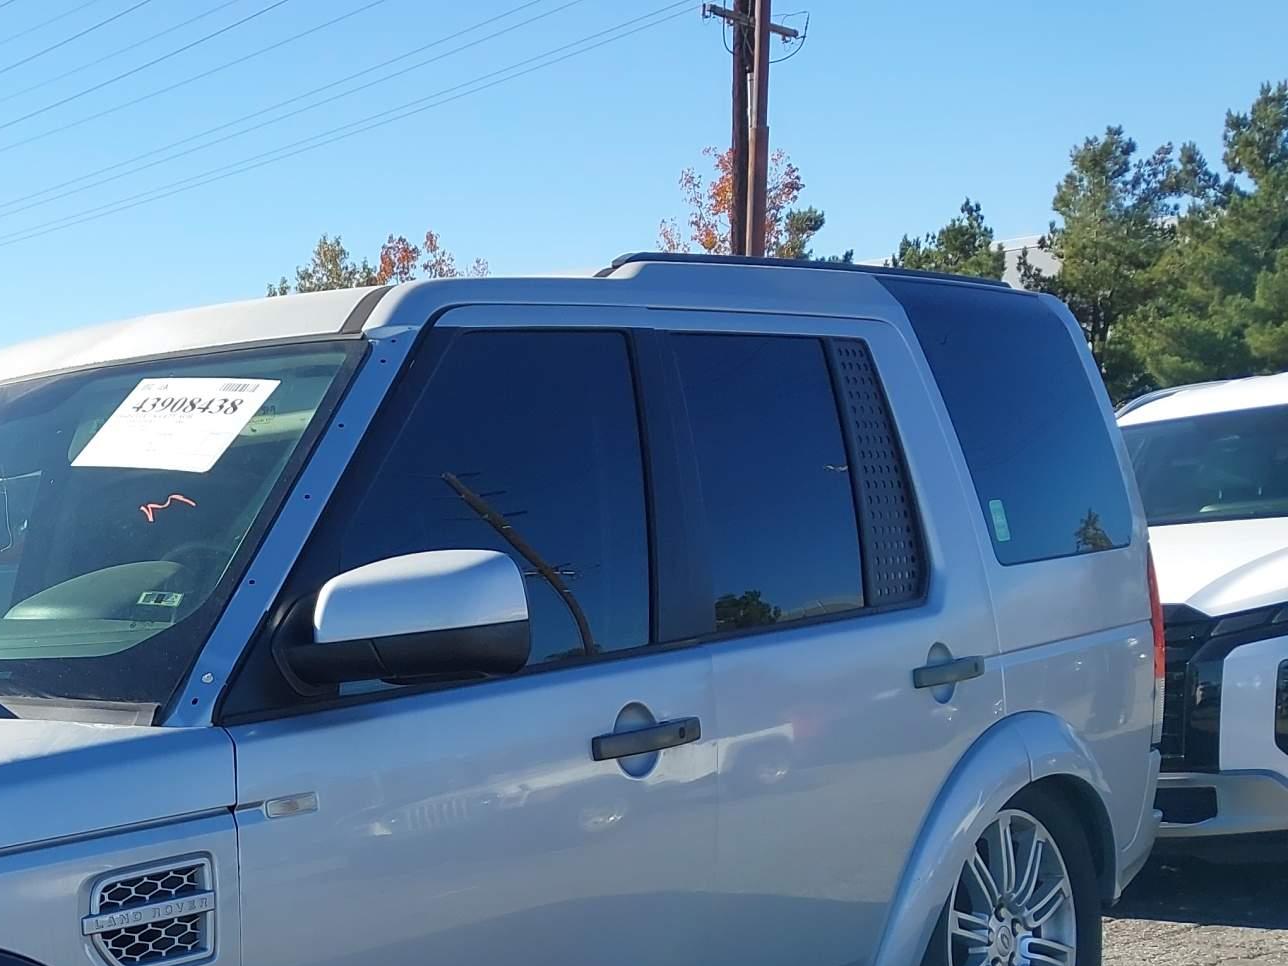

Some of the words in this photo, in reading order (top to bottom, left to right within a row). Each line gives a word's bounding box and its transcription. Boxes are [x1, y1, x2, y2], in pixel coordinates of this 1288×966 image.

[132, 396, 244, 415] 43908438
[95, 911, 143, 929] LAND
[153, 897, 208, 917] ROVER
